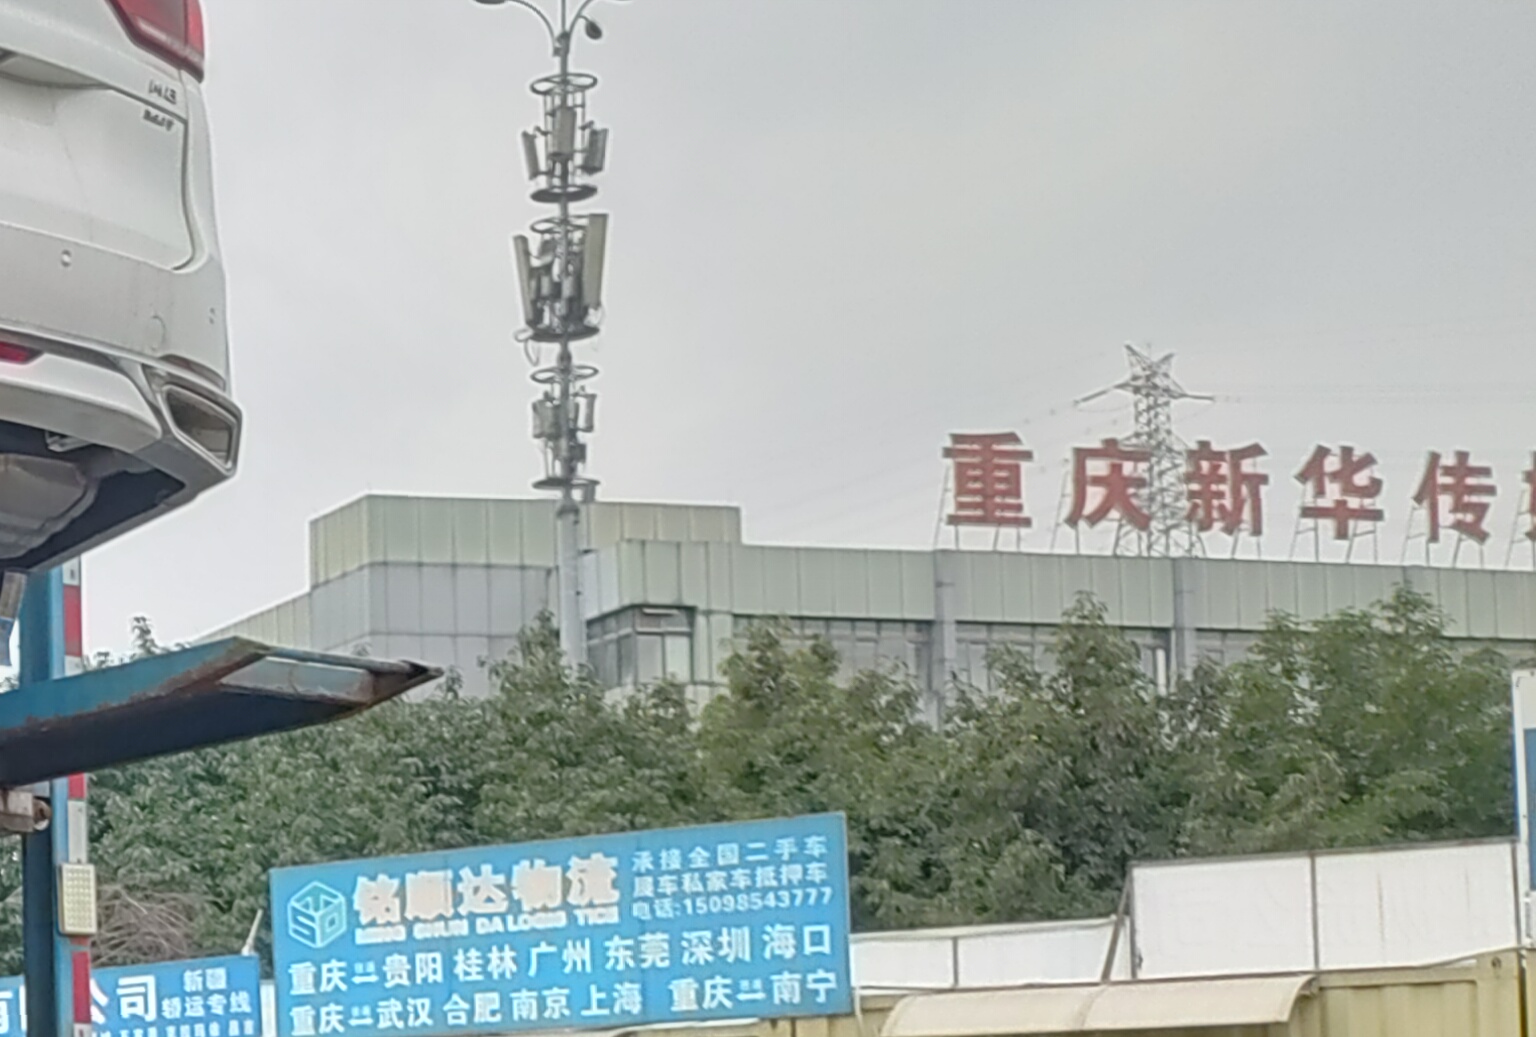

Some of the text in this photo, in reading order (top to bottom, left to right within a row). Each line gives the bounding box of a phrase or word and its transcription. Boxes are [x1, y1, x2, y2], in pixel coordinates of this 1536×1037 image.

[942, 431, 1536, 544] 重庆新华传
[183, 967, 227, 993] 新疆
[288, 923, 831, 995] 重庆 贵阳 桂林 广州 东莞 深圳 海口
[289, 1002, 346, 1036] 重庆
[376, 996, 434, 1030] 武汉
[443, 991, 503, 1026] 合肥
[509, 986, 571, 1022] 南京
[580, 981, 644, 1017] 上海
[668, 975, 734, 1012] 重庆
[770, 968, 838, 1005] 南宁
